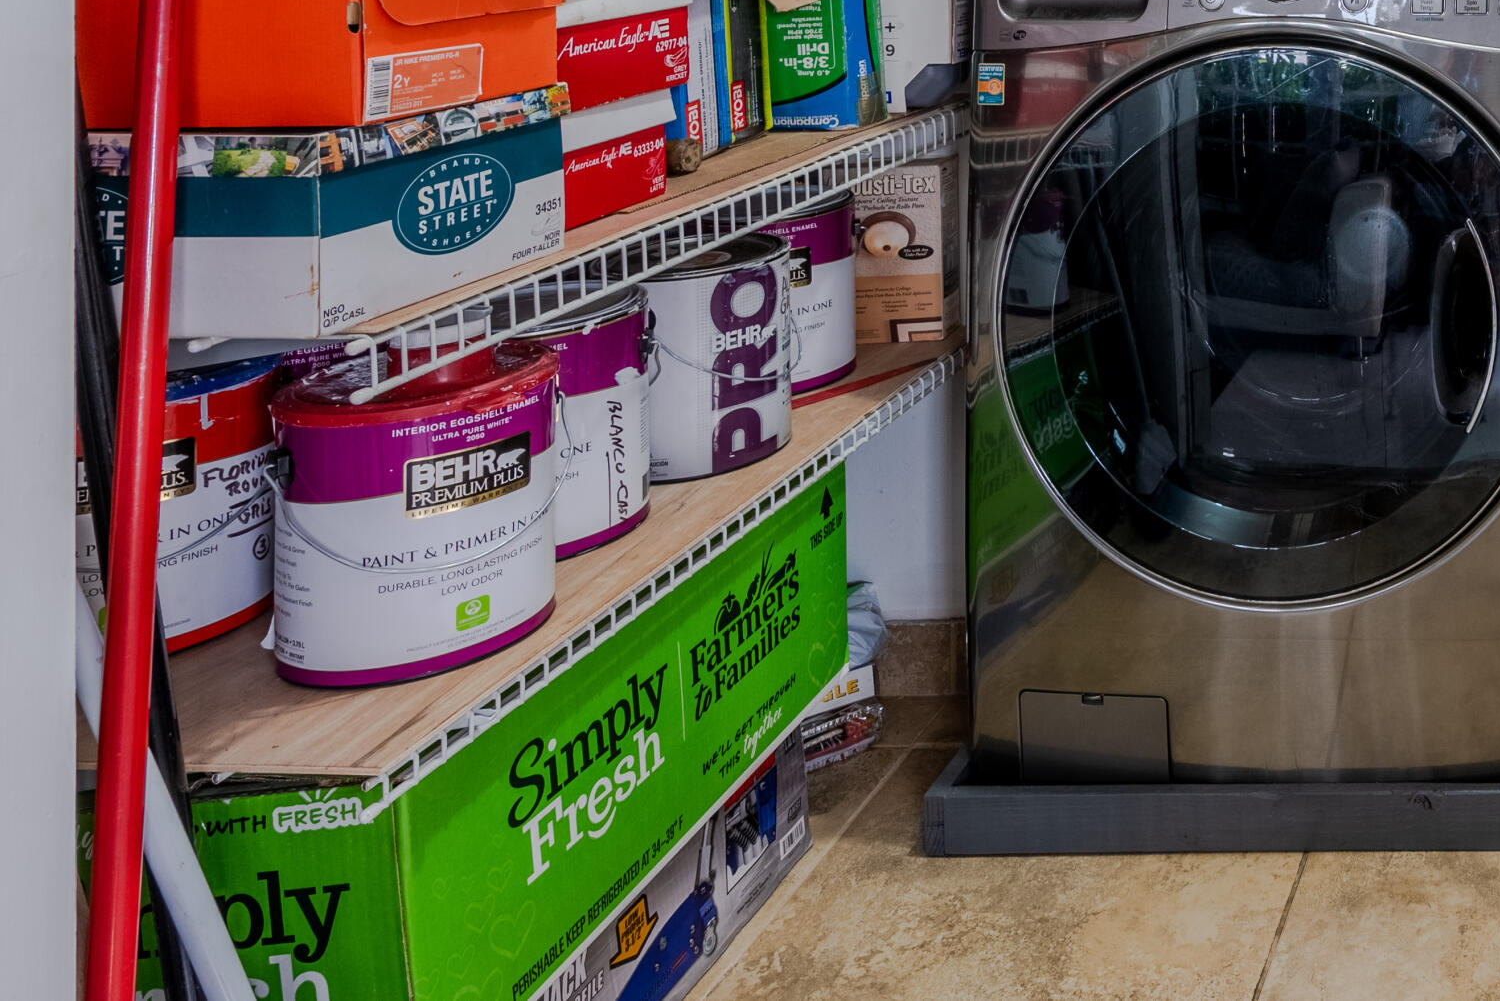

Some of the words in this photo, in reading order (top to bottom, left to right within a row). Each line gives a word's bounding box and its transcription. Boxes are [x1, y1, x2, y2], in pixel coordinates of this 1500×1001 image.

[557, 37, 616, 61] American
[618, 26, 647, 53] Eagle
[655, 36, 688, 53] 62977-04
[797, 42, 830, 56] Drill
[673, 64, 688, 74] GREY
[778, 55, 830, 69] 3/8-in.
[733, 84, 745, 129] RYOBI
[773, 115, 840, 128] Companion
[429, 156, 481, 179] BRAND
[565, 157, 600, 178] American
[633, 137, 665, 157] 63333-04
[417, 168, 494, 217] STATE
[535, 196, 562, 216] 34351
[418, 201, 494, 236] STREET
[791, 222, 818, 233] ENAMEL
[431, 224, 483, 247] SHOES
[544, 230, 561, 243] NOIR
[323, 303, 345, 318] NGO
[323, 314, 340, 328] Q/P
[341, 306, 366, 322] CASL
[796, 304, 810, 316] IN
[811, 298, 833, 314] ONE
[711, 324, 770, 353] BEHR
[803, 321, 826, 332] FINISH
[710, 264, 778, 474] PRO
[391, 421, 447, 439] INTERIOR
[450, 407, 505, 429] EGGSHELL
[506, 395, 540, 413] ENAMEL
[431, 430, 460, 443] ULTRA
[462, 424, 486, 437] PURE
[466, 432, 485, 443] 2050
[411, 448, 498, 493] BEHR
[411, 476, 489, 508] PREMIUM
[493, 464, 524, 488] PLUS
[411, 499, 467, 518] LIFETIME
[168, 522, 192, 541] IN
[362, 550, 415, 569] PAINT
[424, 546, 438, 559] &
[444, 526, 508, 557] PRIMER
[511, 518, 527, 534] IN
[809, 530, 825, 552] THIS
[823, 522, 836, 542] SIDE
[834, 514, 844, 534] UP
[181, 544, 219, 566] FINISH
[518, 536, 543, 557] FINISH
[441, 581, 468, 597] LOW
[470, 568, 504, 589] ODOR
[689, 567, 800, 688] Farmers
[694, 679, 713, 722] to
[714, 603, 800, 701] Families
[702, 740, 731, 776] WE'LL
[734, 715, 753, 743] GET
[755, 673, 797, 723] THROUGH
[508, 663, 669, 828] Simply
[719, 753, 742, 778] THIS
[742, 706, 783, 758] together
[277, 804, 358, 829] FRESH
[522, 727, 666, 886] Fresh
[207, 814, 267, 837] WITH
[511, 939, 566, 1001] PERISHABLE
[566, 916, 588, 948] KEEP
[587, 862, 641, 923] REFRIGERATED
[640, 854, 652, 874] AT
[678, 813, 684, 828] F
